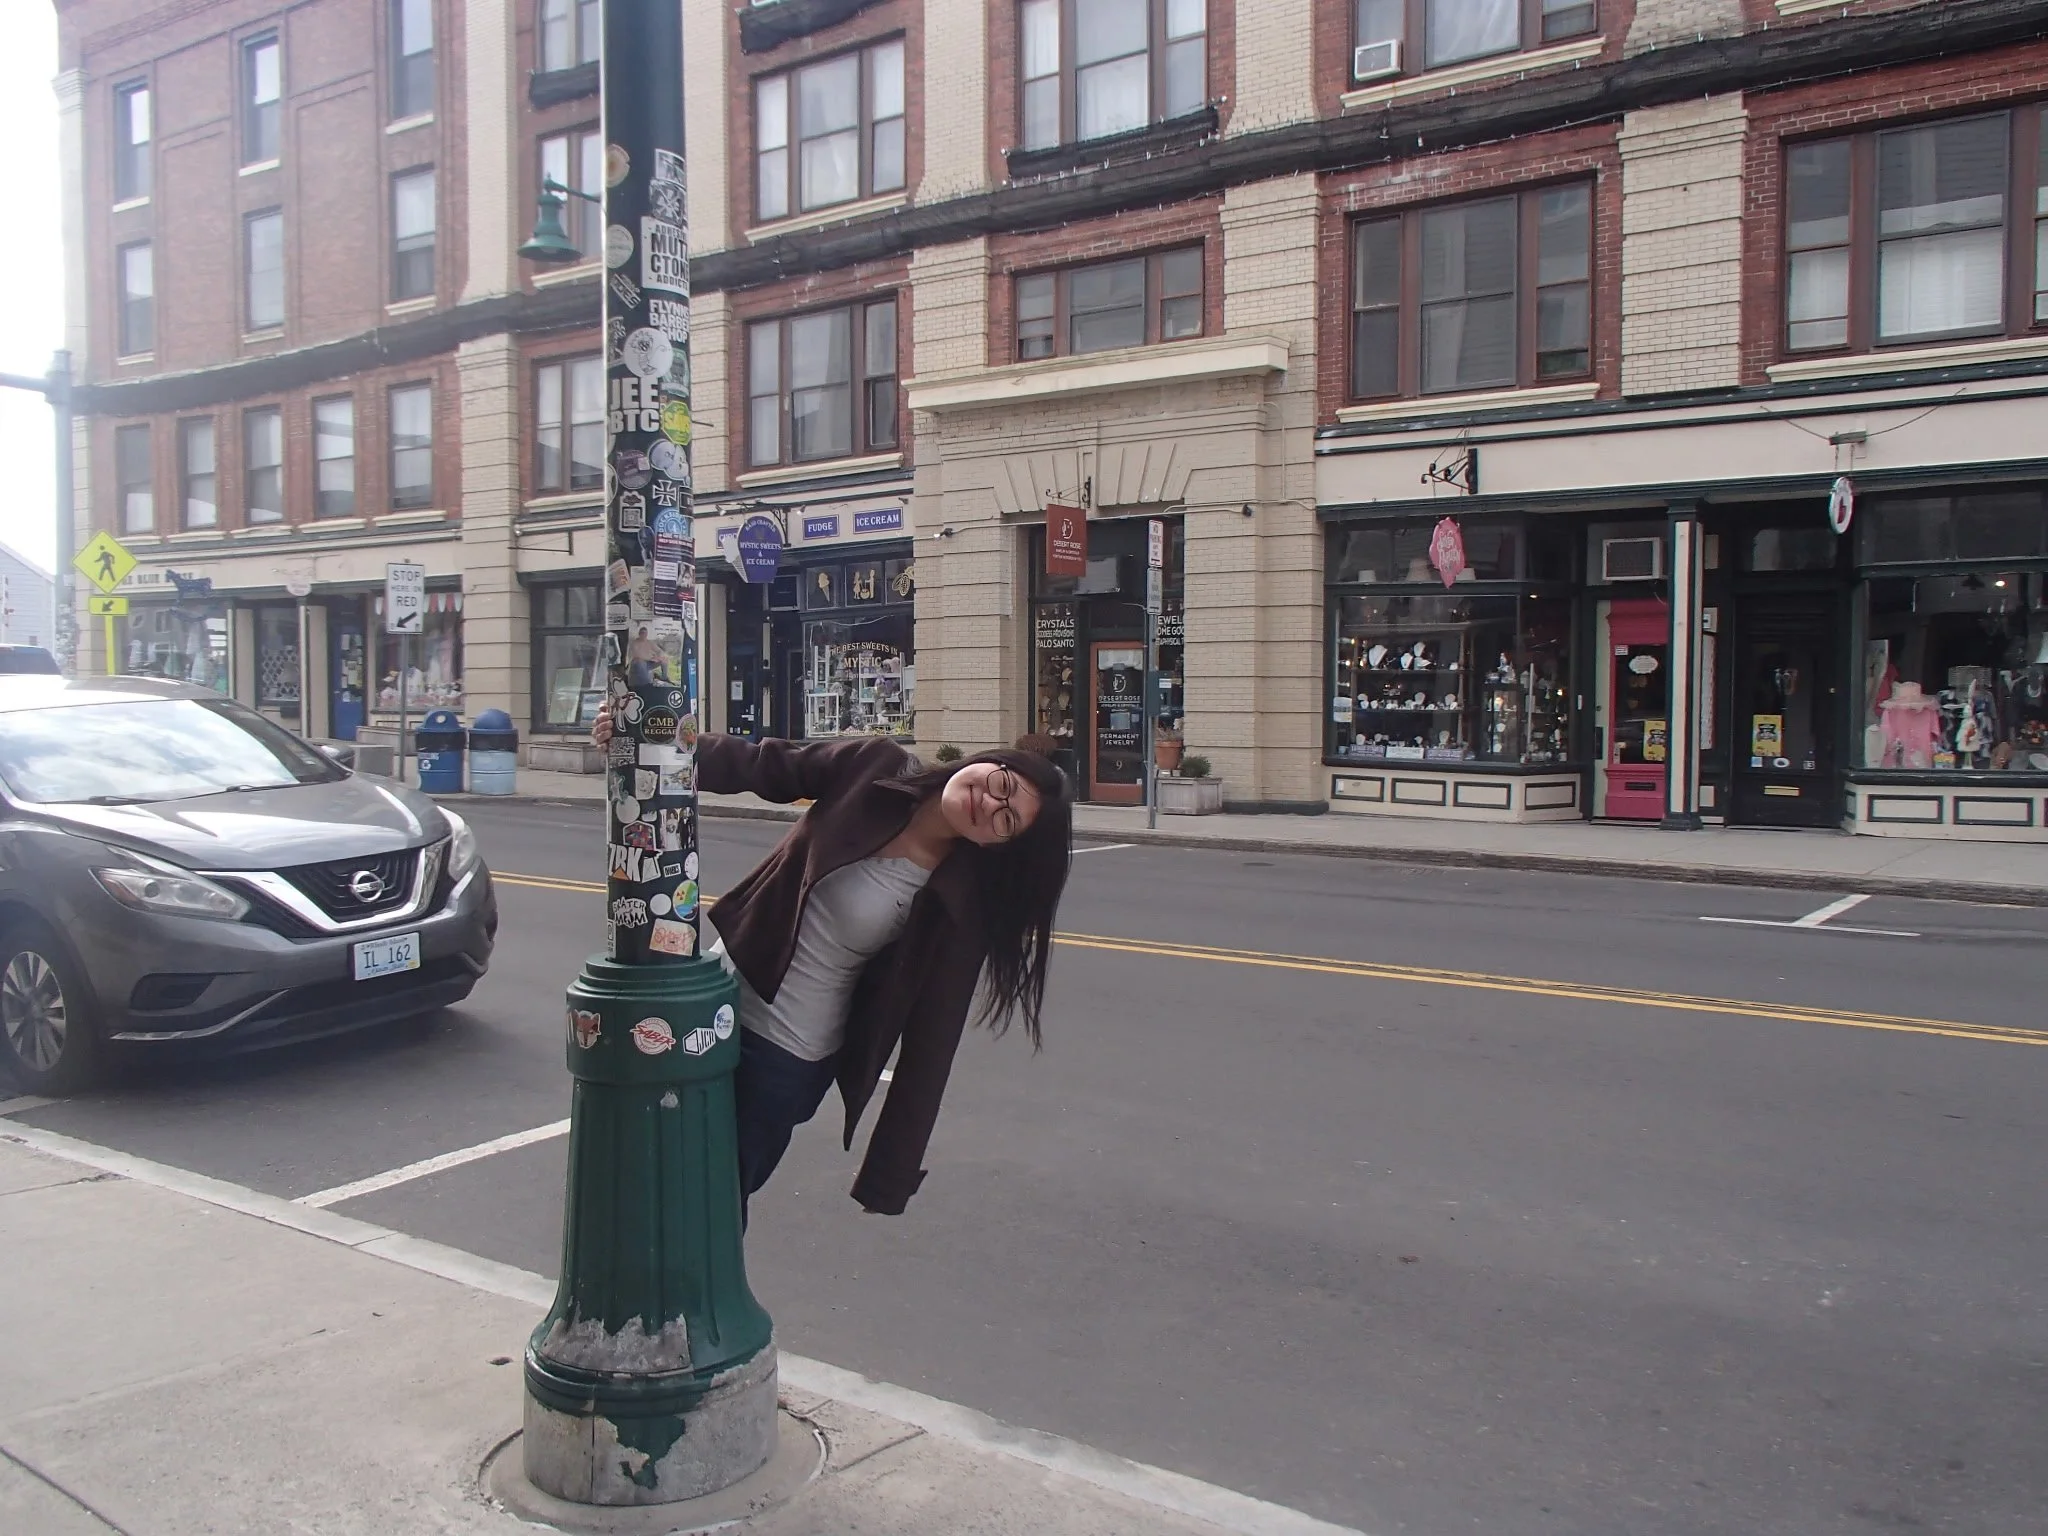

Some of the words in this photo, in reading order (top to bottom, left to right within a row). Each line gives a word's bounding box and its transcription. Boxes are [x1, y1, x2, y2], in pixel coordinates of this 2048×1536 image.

[610, 408, 660, 433] BTC
[856, 517, 870, 527] ICE
[870, 513, 900, 526] CREAM
[808, 521, 833, 533] FUDGE
[740, 541, 760, 549] MYSTIC
[760, 542, 781, 550] SWEETS
[756, 558, 775, 566] CREAM
[393, 570, 420, 582] STOP
[396, 596, 417, 607] RED
[1036, 619, 1075, 629] CRYSTALS
[1157, 615, 1184, 625] EWEL
[842, 642, 861, 652] BEST
[861, 640, 890, 653] SWEETS
[890, 647, 898, 656] IN
[1035, 639, 1052, 648] PALO
[1053, 639, 1075, 648] SANTO
[844, 656, 882, 669] MYSTIC
[648, 717, 675, 727] CMB
[1116, 760, 1123, 770] 9
[613, 899, 646, 912] SKATER
[363, 951, 379, 969] IL
[388, 943, 411, 964] 162
[633, 1024, 675, 1046] SABER
